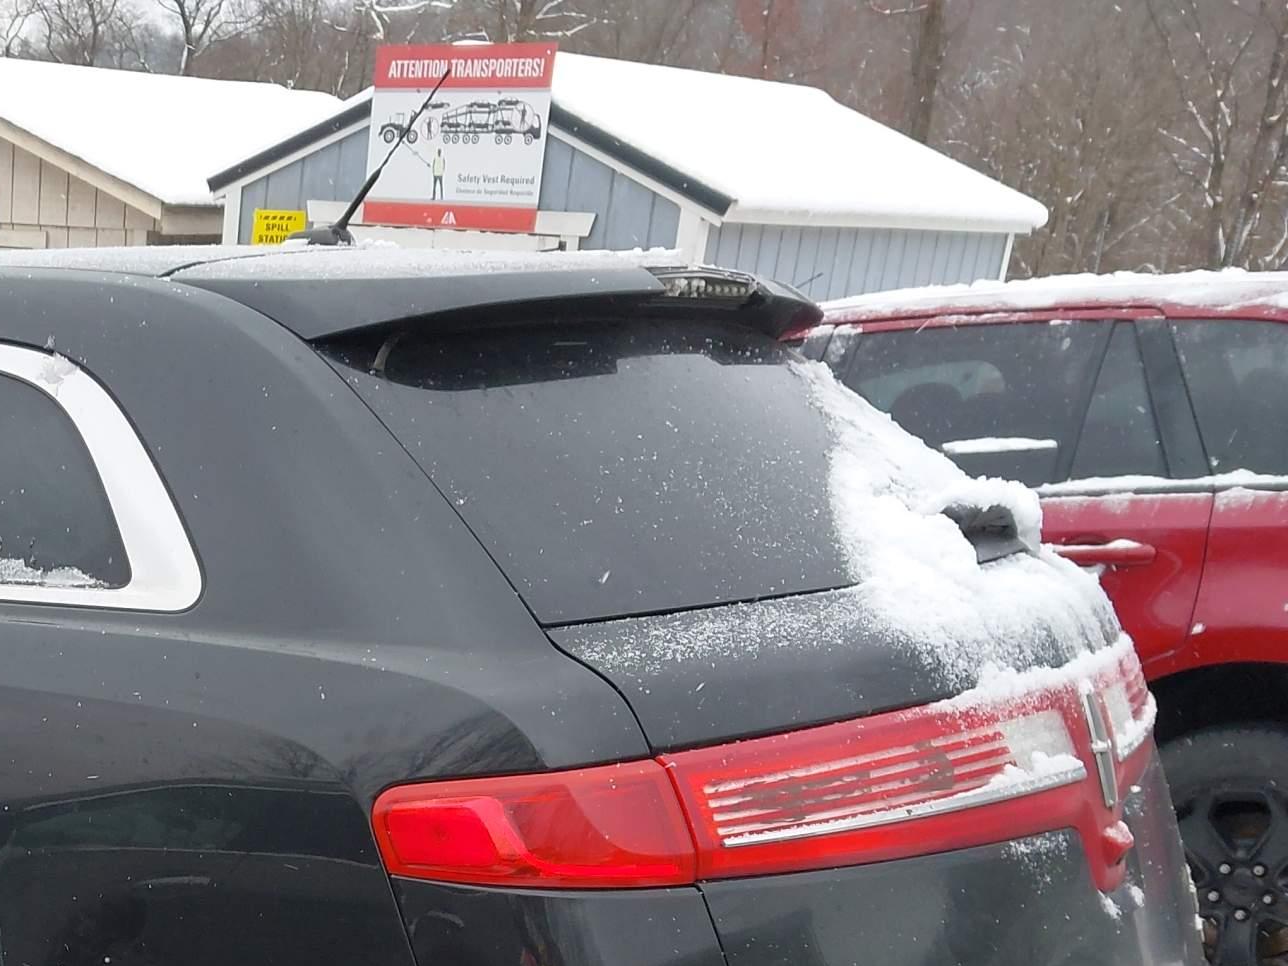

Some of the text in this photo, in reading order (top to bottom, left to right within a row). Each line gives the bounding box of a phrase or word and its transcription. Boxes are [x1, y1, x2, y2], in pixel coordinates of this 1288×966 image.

[388, 58, 545, 79] ATTENTION TRANSPORTERS!
[457, 173, 535, 186] Safety Vest Required
[265, 223, 289, 232] SPILL
